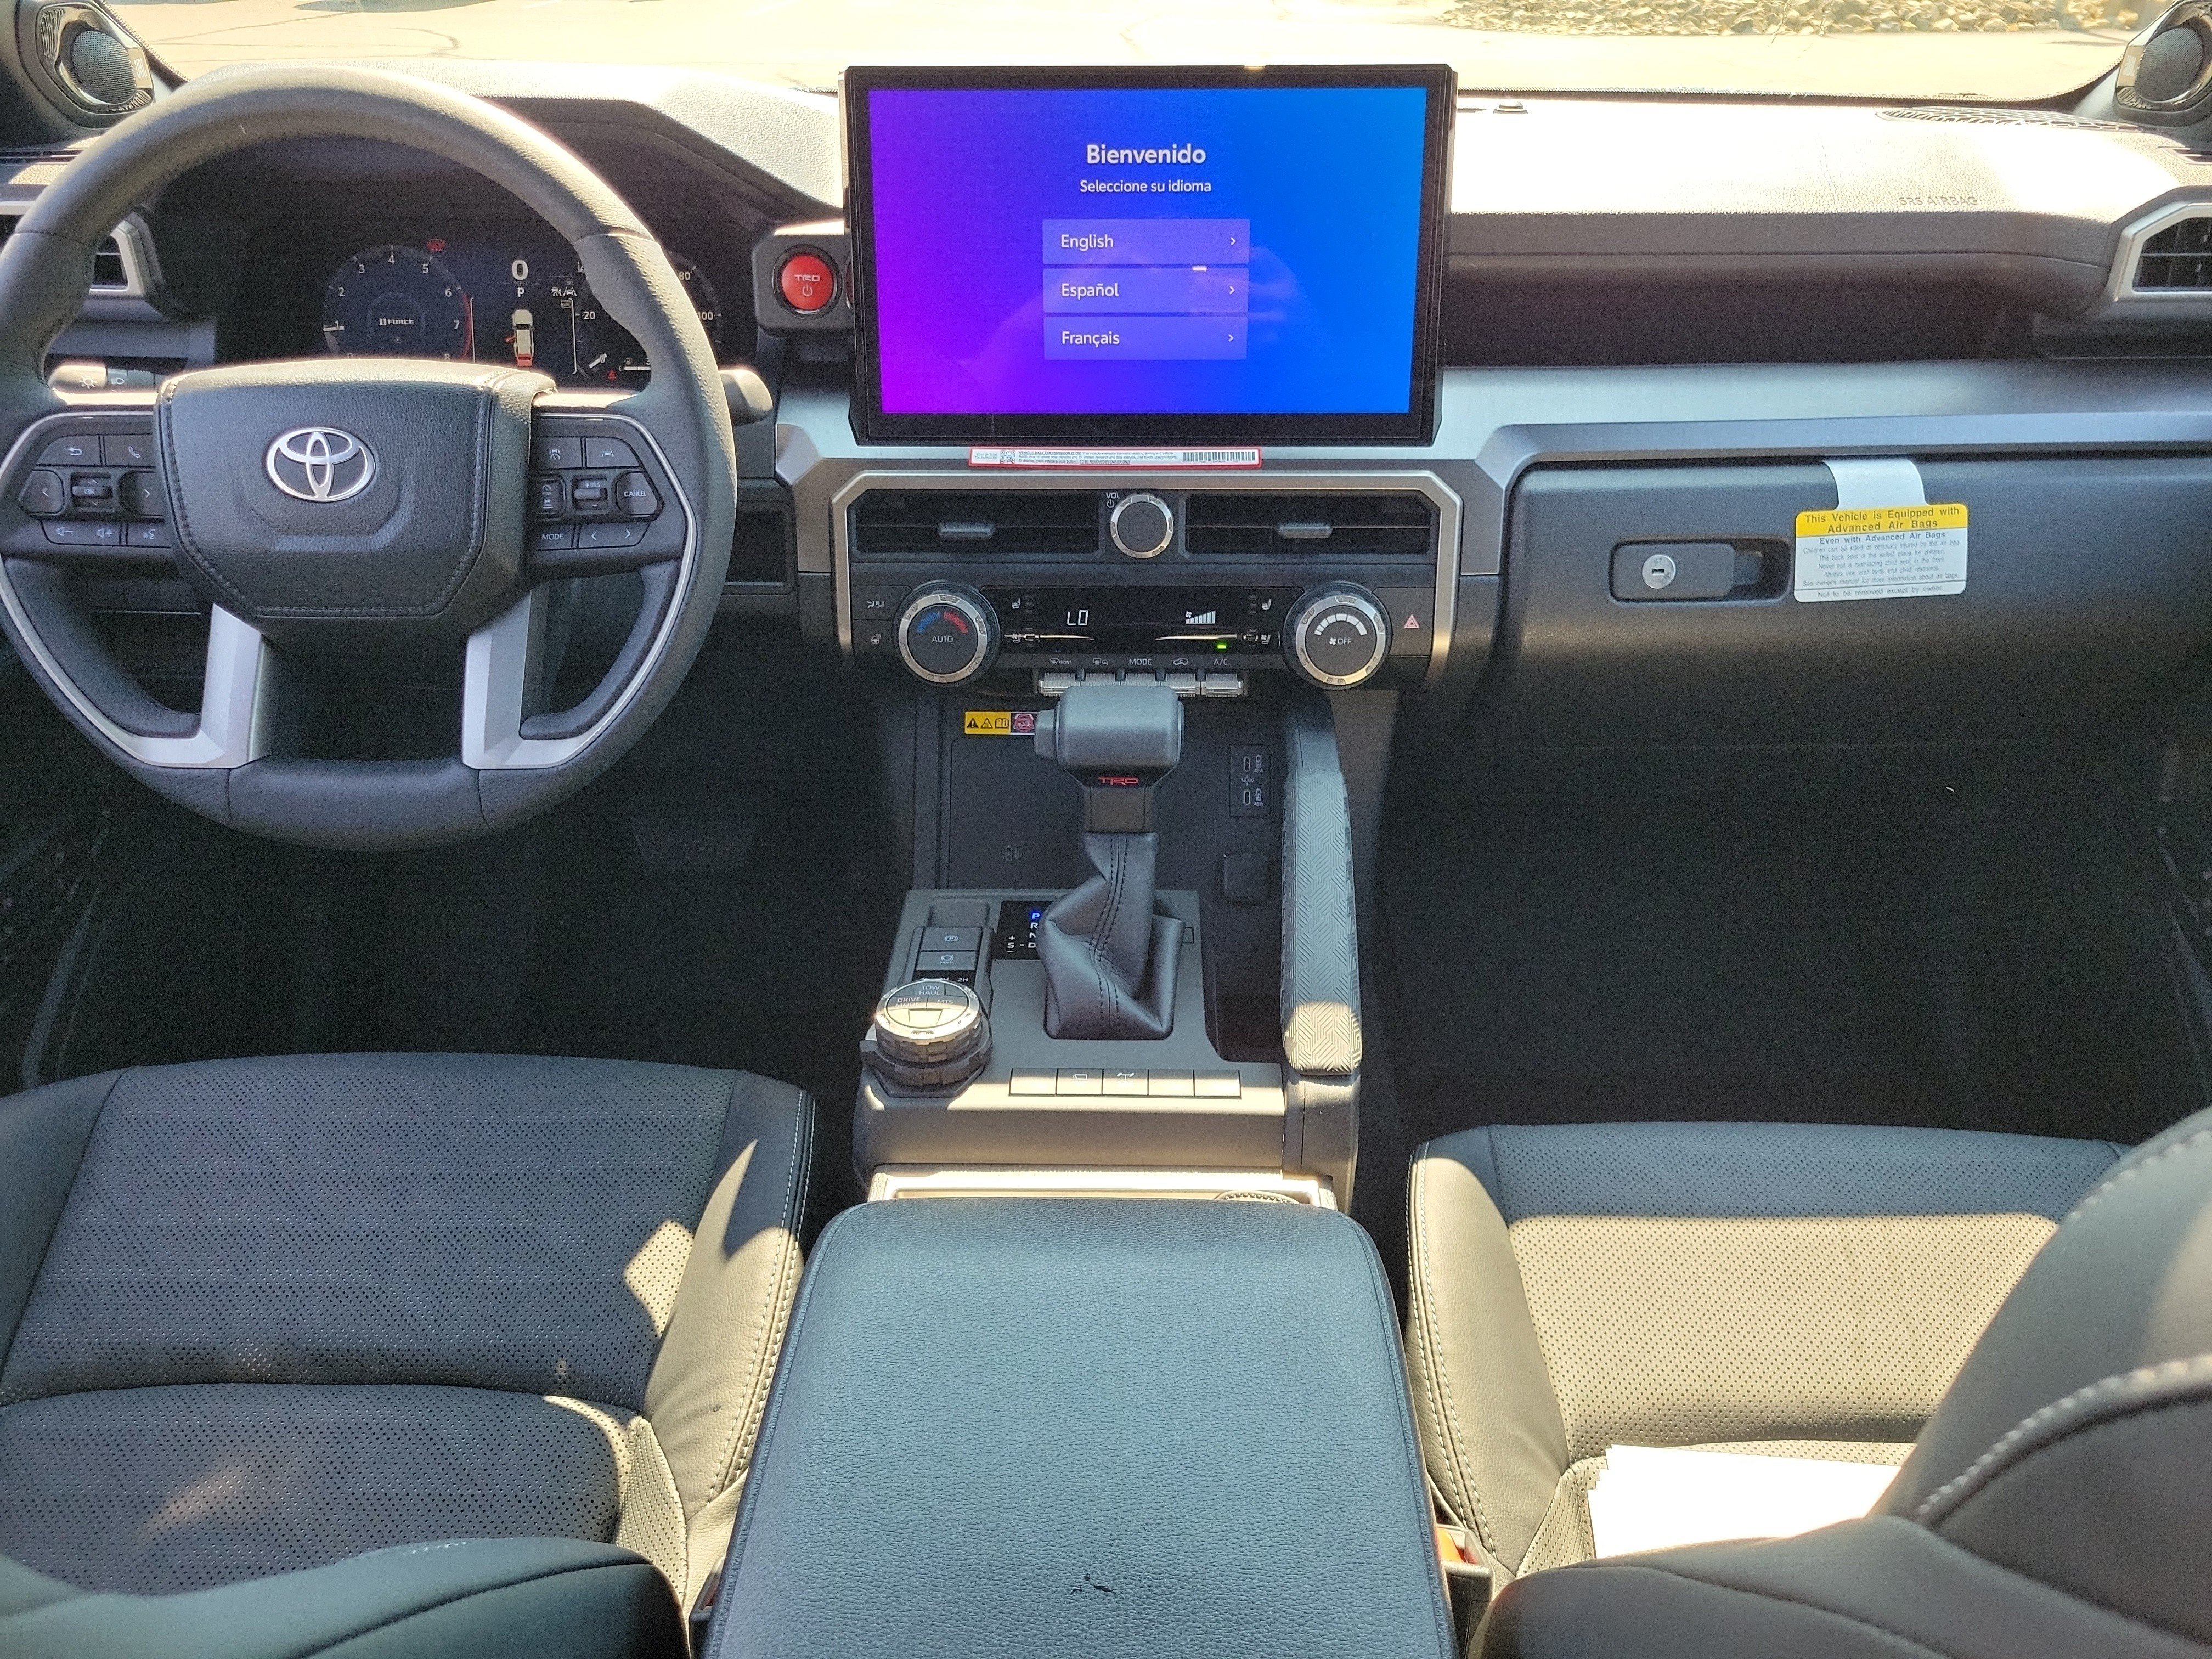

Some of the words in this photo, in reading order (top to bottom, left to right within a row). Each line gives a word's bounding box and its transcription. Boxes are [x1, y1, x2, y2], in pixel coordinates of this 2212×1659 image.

[1087, 143, 1206, 164] Bienvenido
[1080, 179, 1148, 193] Seleccione
[1150, 182, 1165, 193] su
[1168, 179, 1211, 192] idioma
[1899, 196, 1923, 206] SRS
[1927, 196, 1978, 206] AIRBAG
[1061, 233, 1114, 252] English
[388, 254, 395, 264] 4
[358, 264, 365, 274] 3
[422, 264, 429, 274] 5
[512, 259, 528, 280] 0
[679, 272, 691, 281] 80
[338, 287, 345, 297] 2
[445, 287, 452, 297] 6
[517, 287, 525, 298] P
[1062, 283, 1119, 300] Español
[583, 311, 596, 320] 20
[697, 311, 714, 321] 100
[453, 320, 460, 330] 7
[1062, 331, 1120, 348] Français
[1805, 514, 1826, 523] This
[1832, 512, 1868, 522] Vehicle
[1888, 507, 1934, 520] Equipped
[1939, 506, 1959, 516] with
[1827, 522, 1881, 533] Advanced
[1888, 521, 1904, 529] Air
[1911, 520, 1938, 529] Bags
[1926, 531, 1945, 539] Bags
[1097, 777, 1138, 785] TRD
